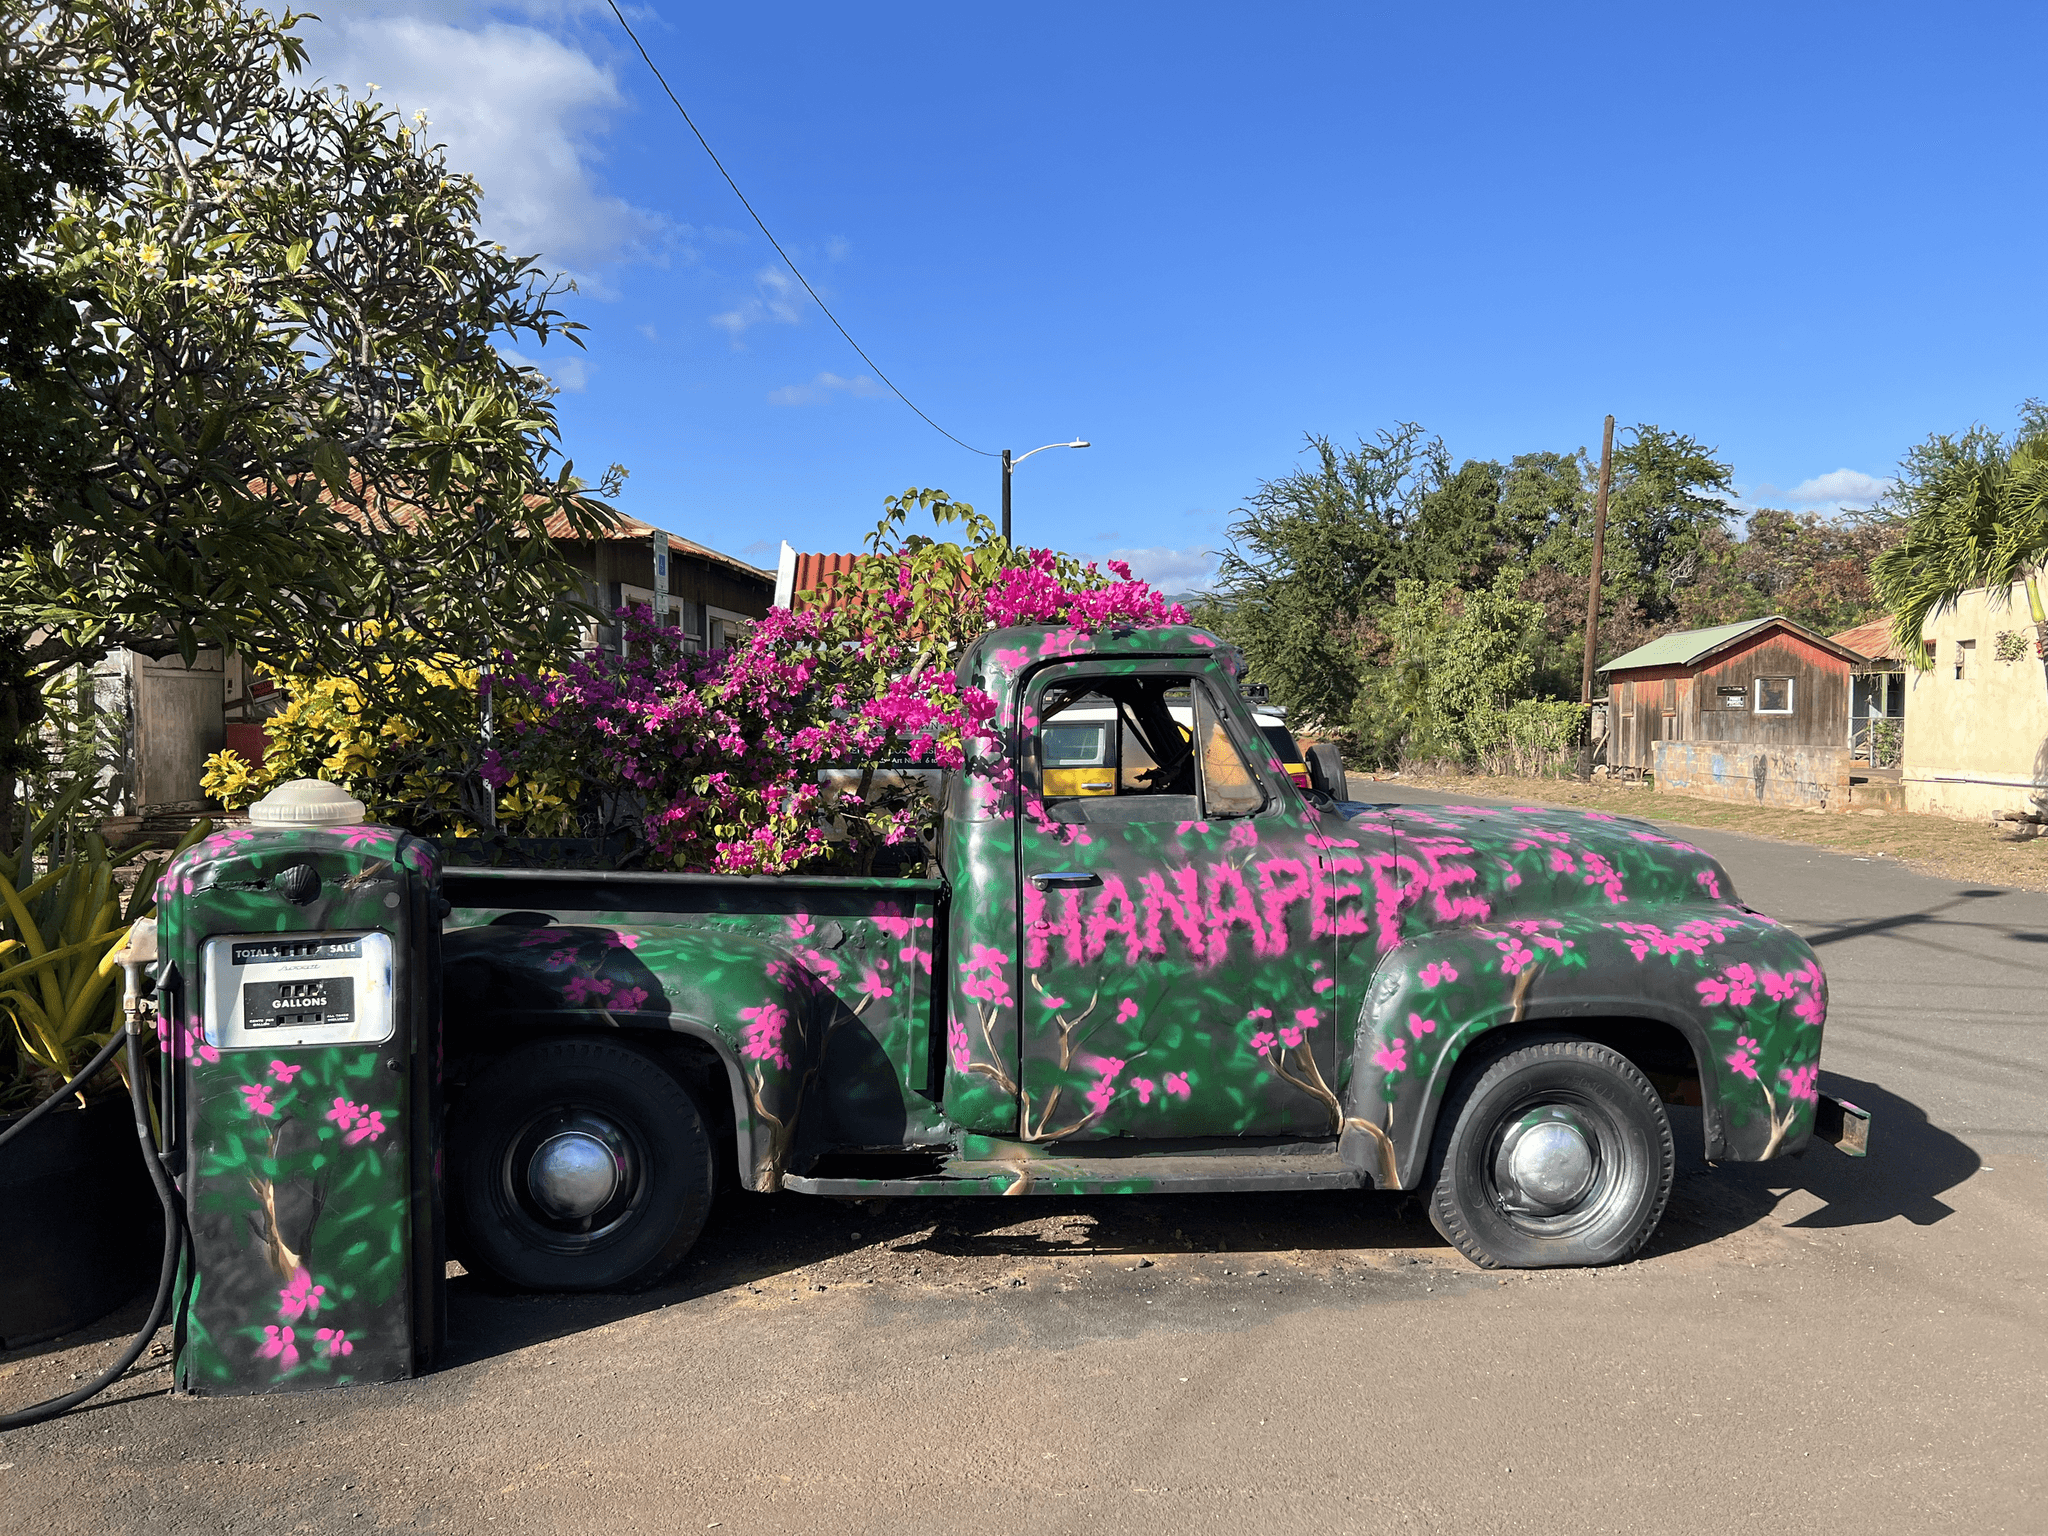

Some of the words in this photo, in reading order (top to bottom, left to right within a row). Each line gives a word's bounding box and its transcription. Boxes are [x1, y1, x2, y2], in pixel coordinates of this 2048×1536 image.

[1024, 844, 1491, 967] HANAPEPE
[235, 948, 269, 958] TOTAL
[329, 943, 356, 953] SALE
[272, 997, 328, 1009] GALLONS
